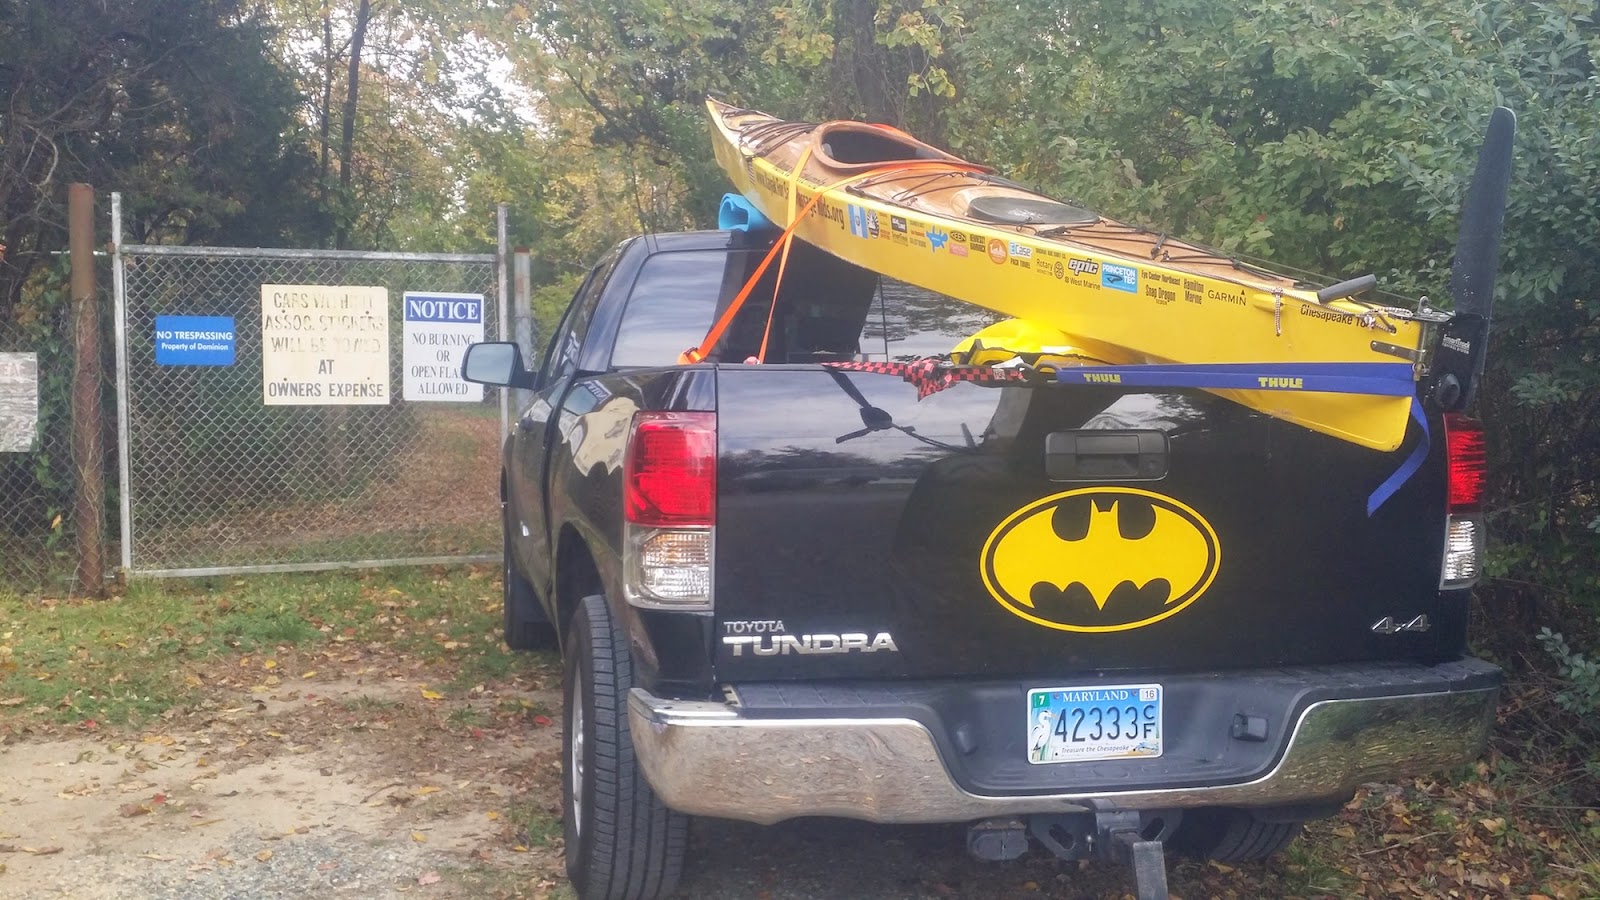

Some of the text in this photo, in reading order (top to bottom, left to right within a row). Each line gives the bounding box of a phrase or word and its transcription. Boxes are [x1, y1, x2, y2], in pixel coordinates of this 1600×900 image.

[1068, 257, 1099, 276] epic
[1102, 263, 1136, 278] PRINCETON
[1070, 277, 1101, 291] West Marine
[1123, 275, 1136, 285] TEC
[273, 291, 309, 309] CARS
[1207, 288, 1247, 307] GARMIN
[408, 300, 479, 320] NOTICE
[1300, 303, 1353, 326] Chesapeake
[156, 331, 234, 341] NO TRESPASSING
[412, 333, 427, 346] NO
[161, 342, 229, 352] Property of Dominion
[436, 350, 451, 362] OR
[318, 359, 335, 375] AT
[411, 366, 461, 379] OPEN FLA
[1083, 373, 1122, 384] THULE
[1258, 376, 1304, 389] THULE
[268, 382, 384, 398] OWNERS EXPENSE
[417, 382, 469, 395] ALLOWED
[723, 620, 786, 634] TOYOTA
[722, 632, 899, 657] TUNDRA
[1039, 690, 1155, 706] 7 MARYLAND 16
[1061, 746, 1085, 754] Treasure
[1096, 744, 1130, 753] Chesapeake
